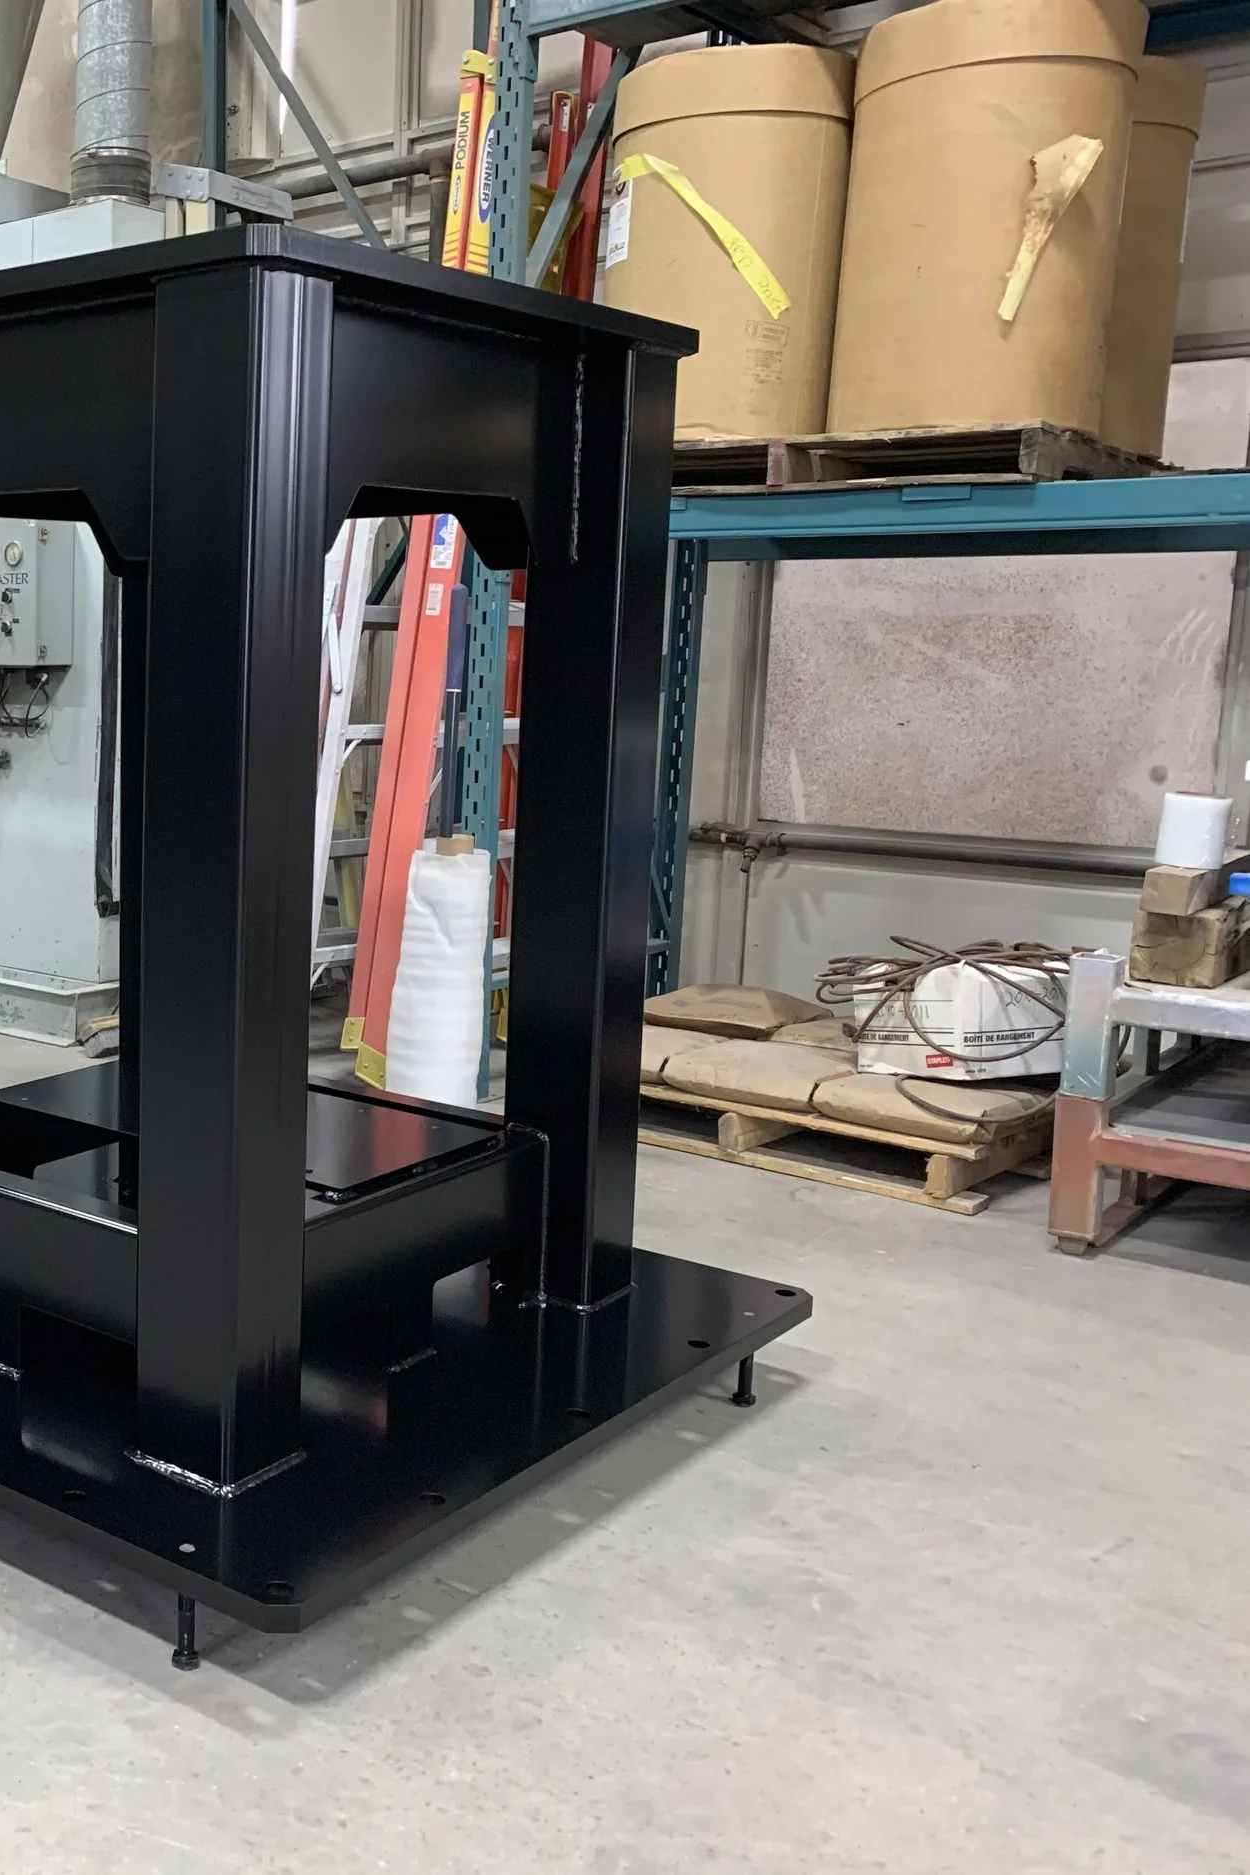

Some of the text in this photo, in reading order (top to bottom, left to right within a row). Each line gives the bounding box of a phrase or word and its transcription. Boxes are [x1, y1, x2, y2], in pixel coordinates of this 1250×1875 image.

[455, 110, 470, 170] PODIUM
[482, 137, 494, 203] WERNER
[985, 1034, 995, 1043] DE
[996, 1031, 1035, 1042] RANGEMENT
